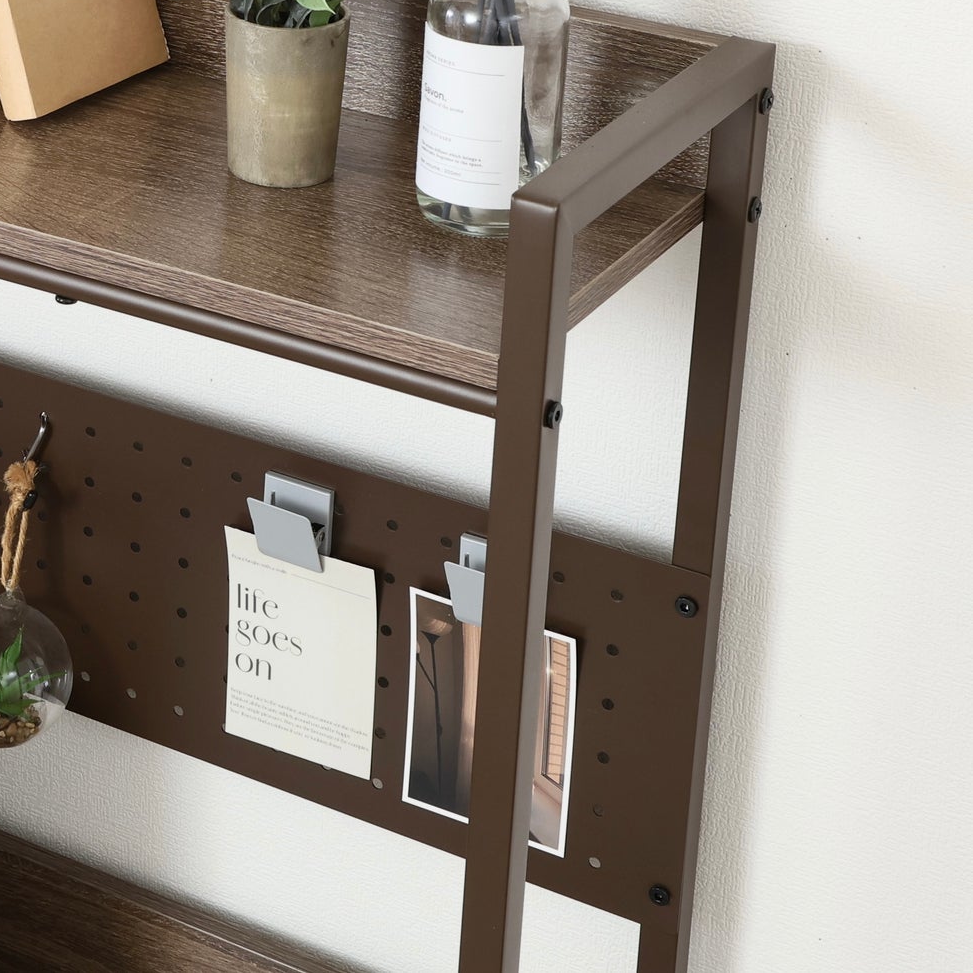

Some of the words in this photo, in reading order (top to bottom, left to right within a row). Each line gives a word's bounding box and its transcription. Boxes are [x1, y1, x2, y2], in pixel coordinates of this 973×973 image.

[237, 583, 279, 620] life
[235, 619, 303, 657] goes
[235, 652, 272, 681] on
